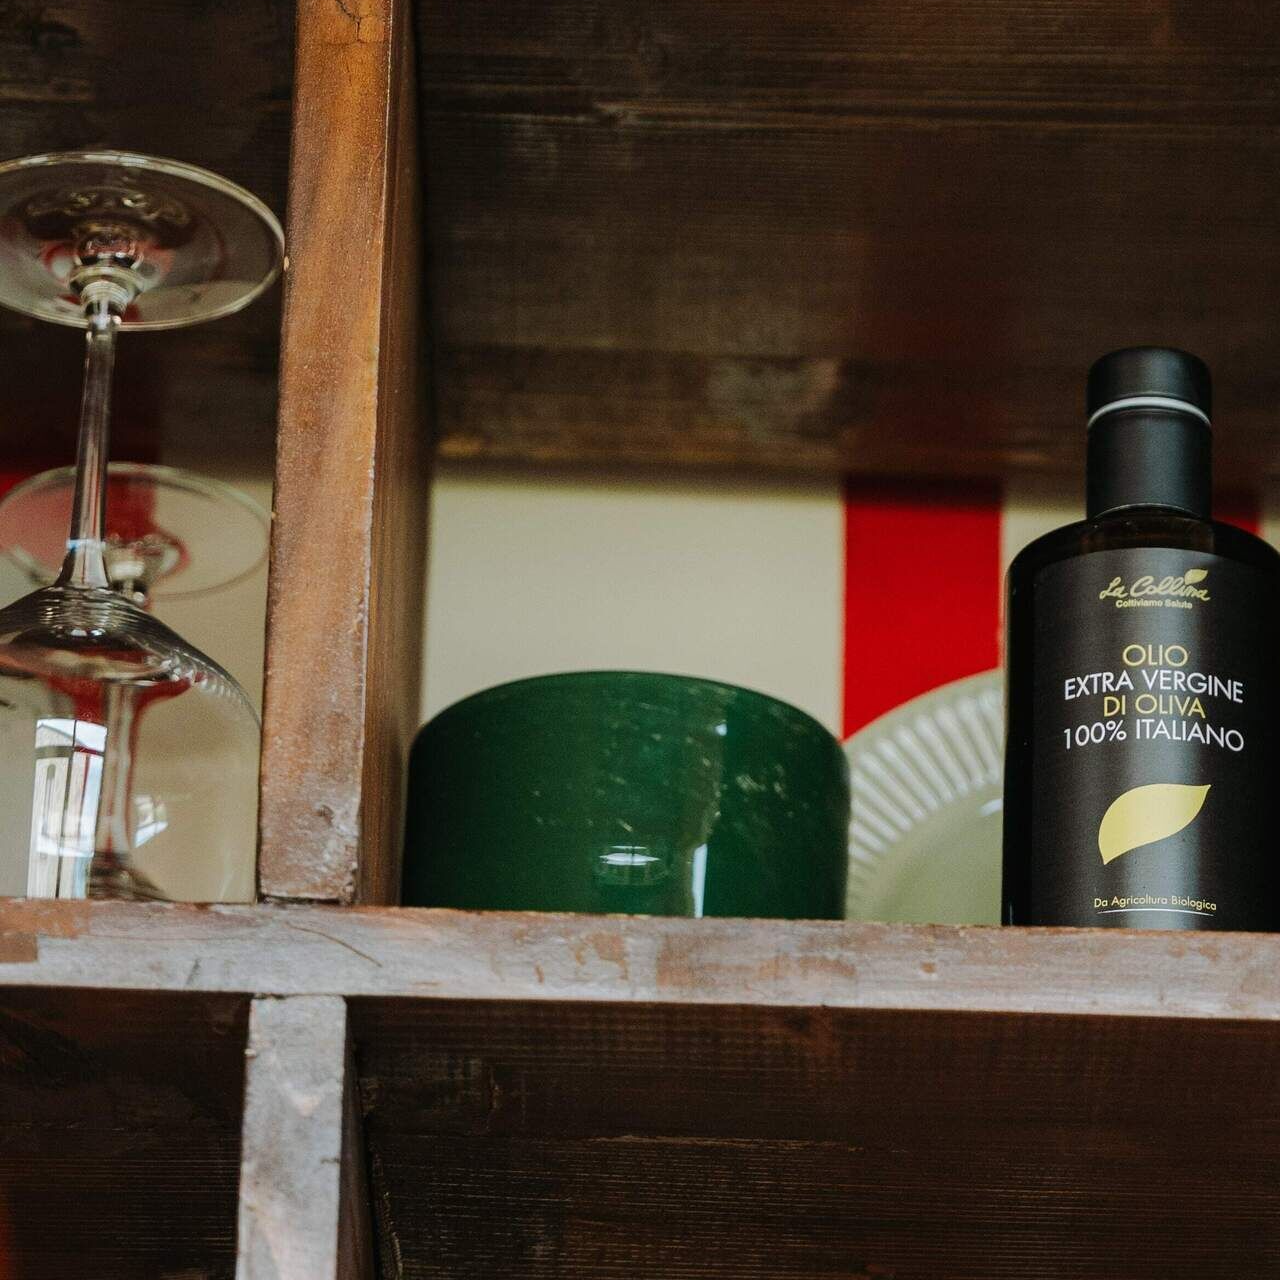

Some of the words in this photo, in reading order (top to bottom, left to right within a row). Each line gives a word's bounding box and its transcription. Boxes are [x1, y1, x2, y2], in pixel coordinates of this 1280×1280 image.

[1099, 576, 1127, 603] La
[1115, 599, 1163, 609] Coltiviamo
[1165, 599, 1193, 609] Salute
[1122, 644, 1189, 667] OLIO
[1064, 671, 1134, 701] EXTRA
[1142, 669, 1244, 704] VERGINE
[1103, 695, 1126, 717] DI
[1135, 693, 1206, 719] OLIVA
[1064, 720, 1127, 751] 100%
[1135, 719, 1244, 752] ITALIANO
[1094, 897, 1109, 909] Da
[1111, 894, 1168, 910] Agricoltura
[1171, 895, 1217, 912] Biologica
